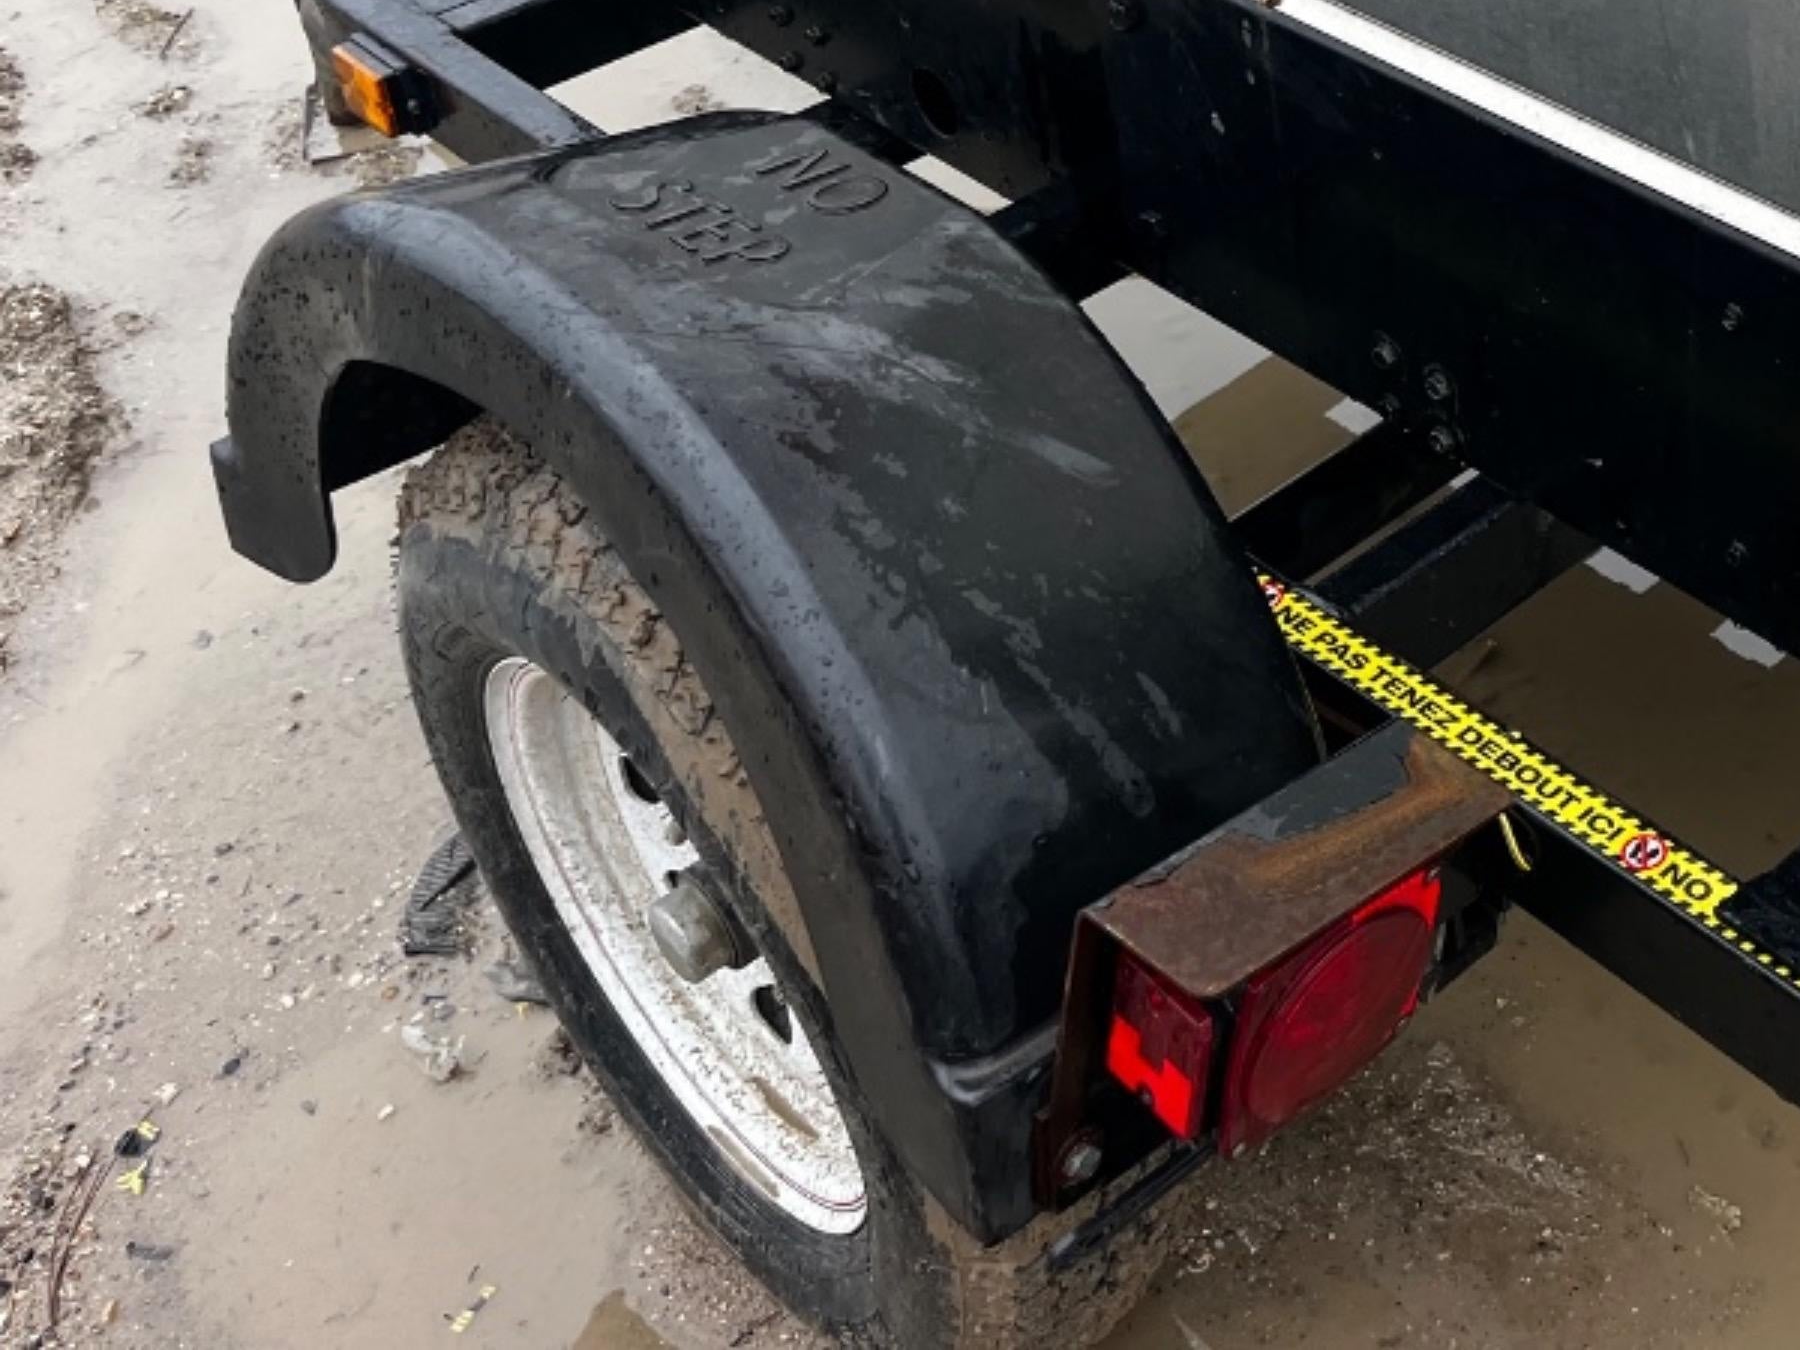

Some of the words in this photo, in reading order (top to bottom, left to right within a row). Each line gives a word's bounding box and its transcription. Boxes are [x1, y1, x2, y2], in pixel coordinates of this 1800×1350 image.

[755, 149, 889, 216] NO
[607, 179, 793, 267] STEP
[1275, 603, 1311, 636] NE
[1316, 630, 1367, 672] PAS
[1369, 663, 1459, 733] TENEZ
[1457, 722, 1582, 819] DEBOUT
[1577, 806, 1624, 843] ICI
[1658, 861, 1712, 901] NO
